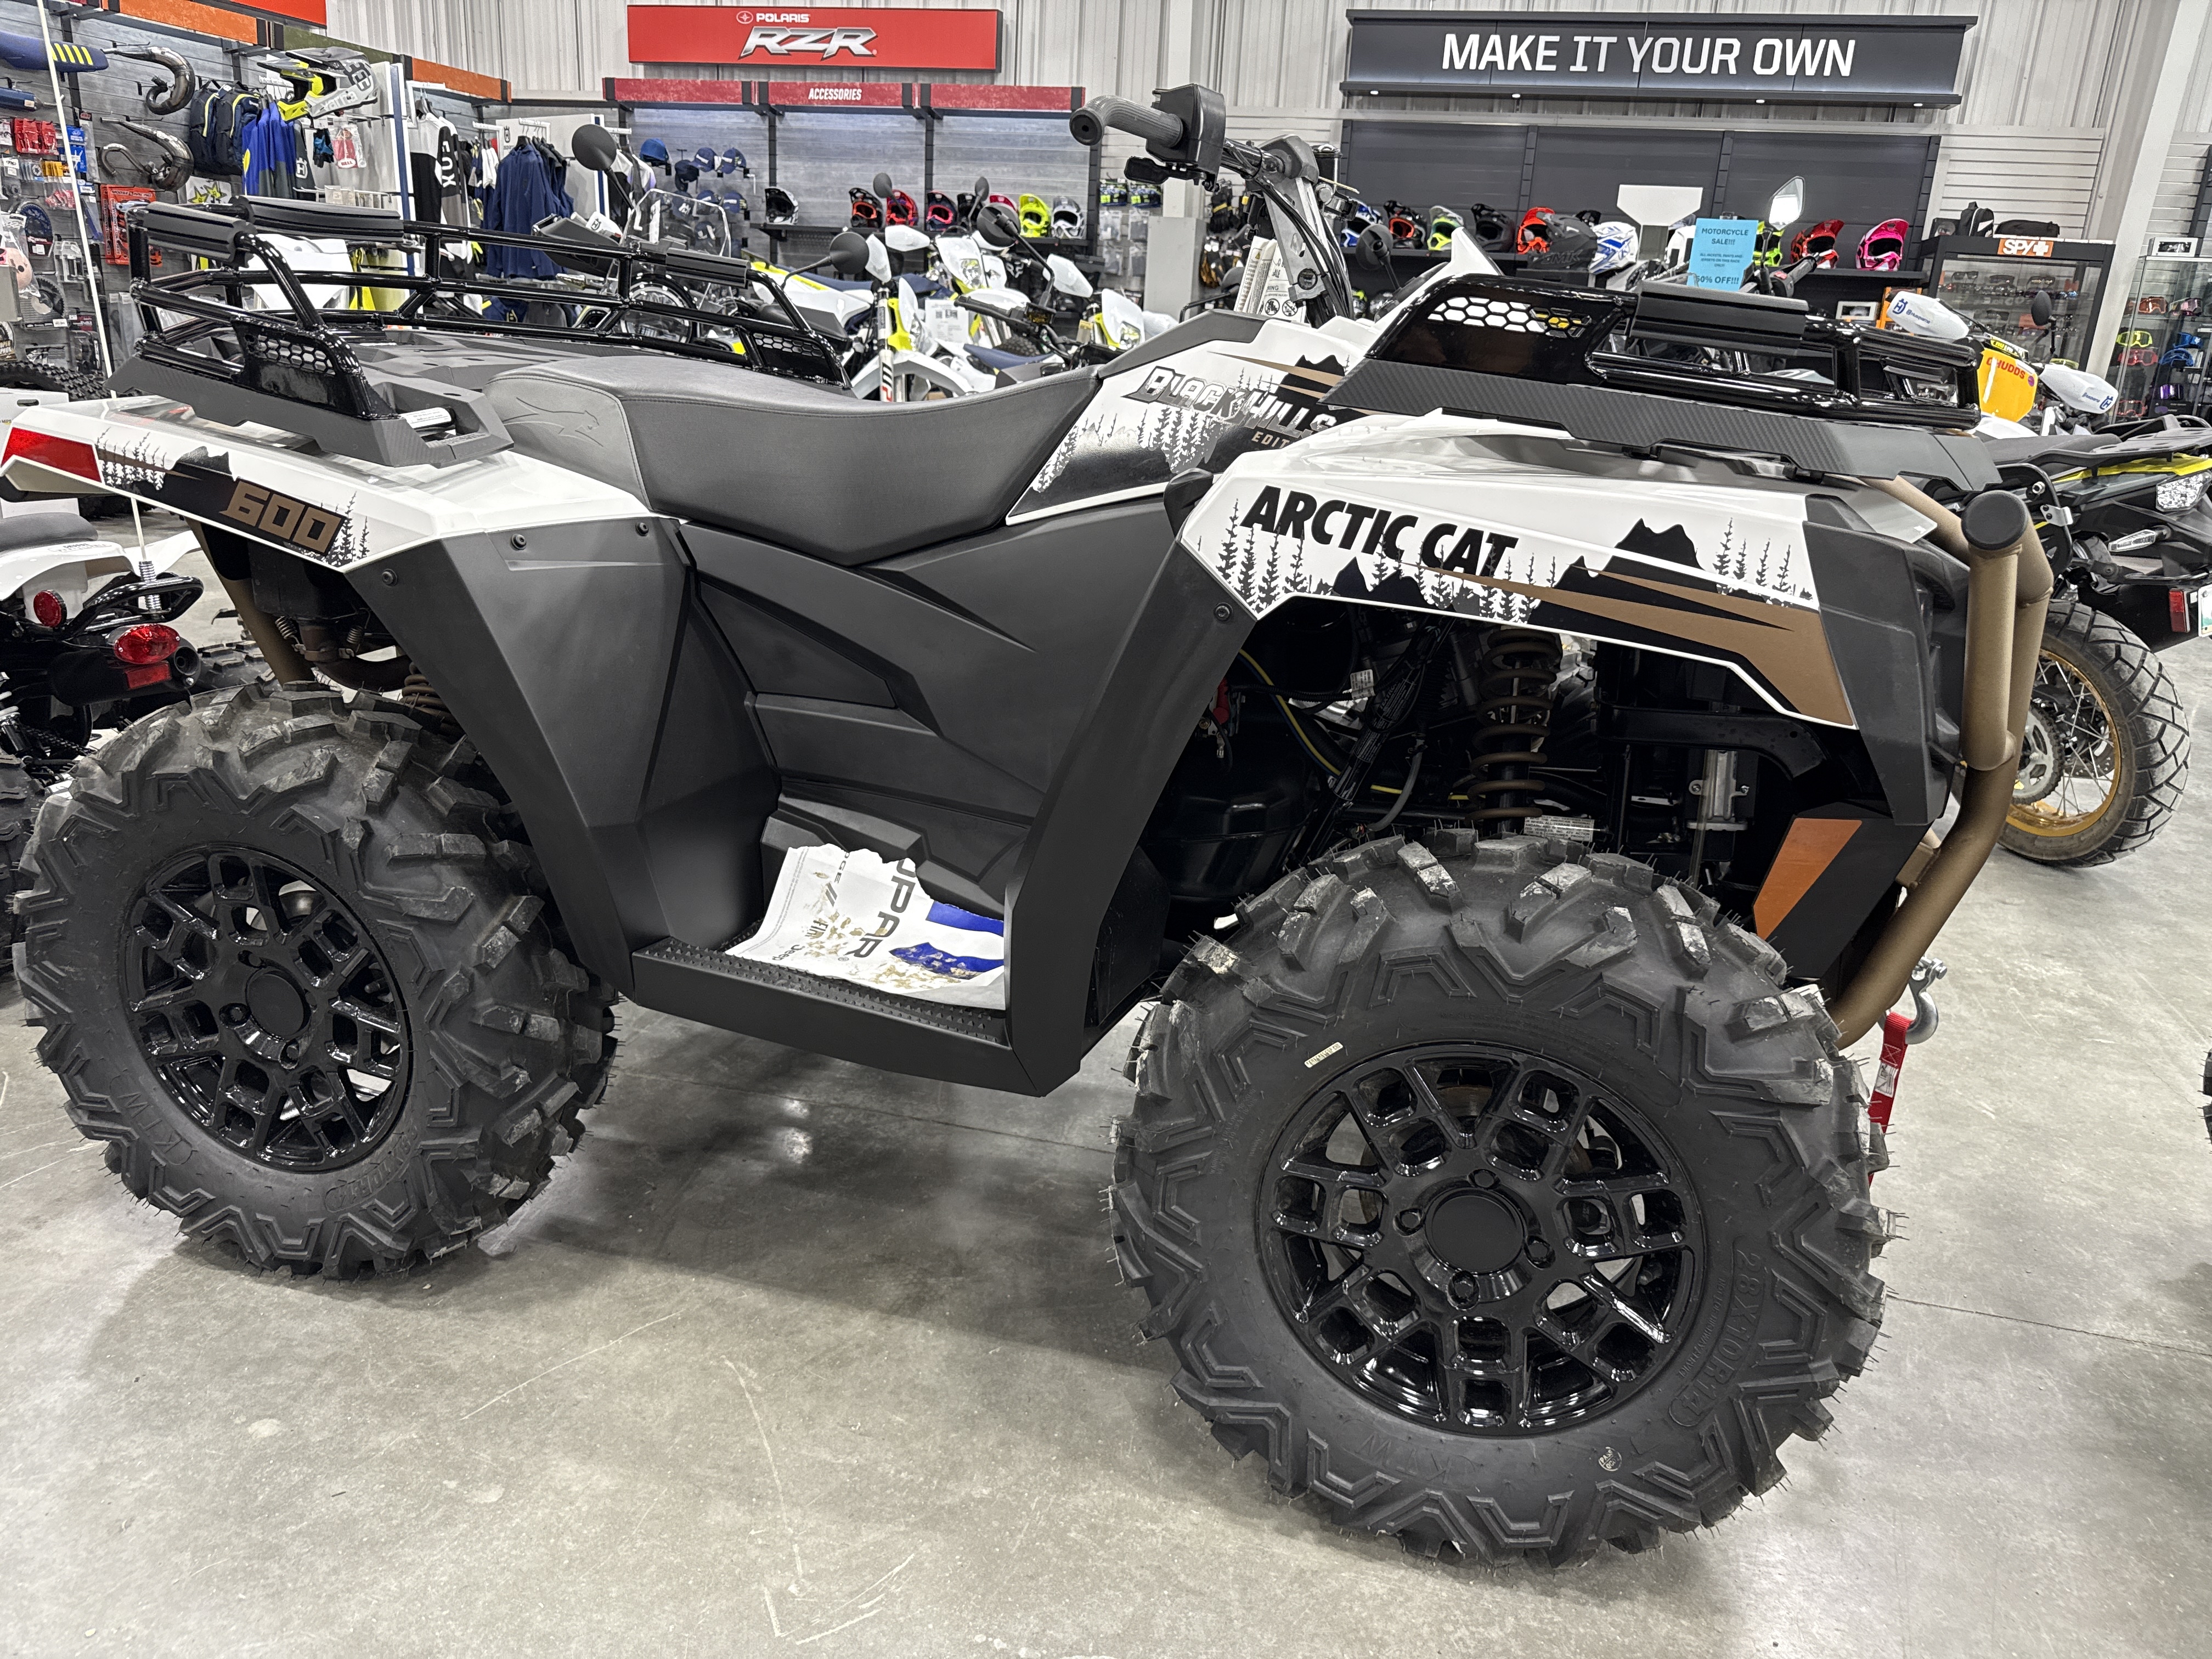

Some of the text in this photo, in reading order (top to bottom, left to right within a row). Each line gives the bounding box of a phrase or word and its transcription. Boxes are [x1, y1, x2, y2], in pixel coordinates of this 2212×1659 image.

[756, 13, 809, 23] POLARIS
[738, 26, 877, 61] RZR
[1442, 33, 1856, 76] MAKE IT YOUR OWN
[808, 88, 862, 101] ACCESSORIES
[442, 140, 456, 188] FOX
[1701, 228, 1749, 236] MOTORCYCLE
[2002, 240, 2035, 256] SPY
[1714, 276, 1740, 285] OFF!!!
[1122, 365, 1337, 436] BLACK HILLS
[219, 482, 345, 554] 600
[1240, 485, 1519, 578] ARCTIC CAT
[771, 944, 803, 961] Jeep
[1682, 1248, 1761, 1416] 28X10R14
